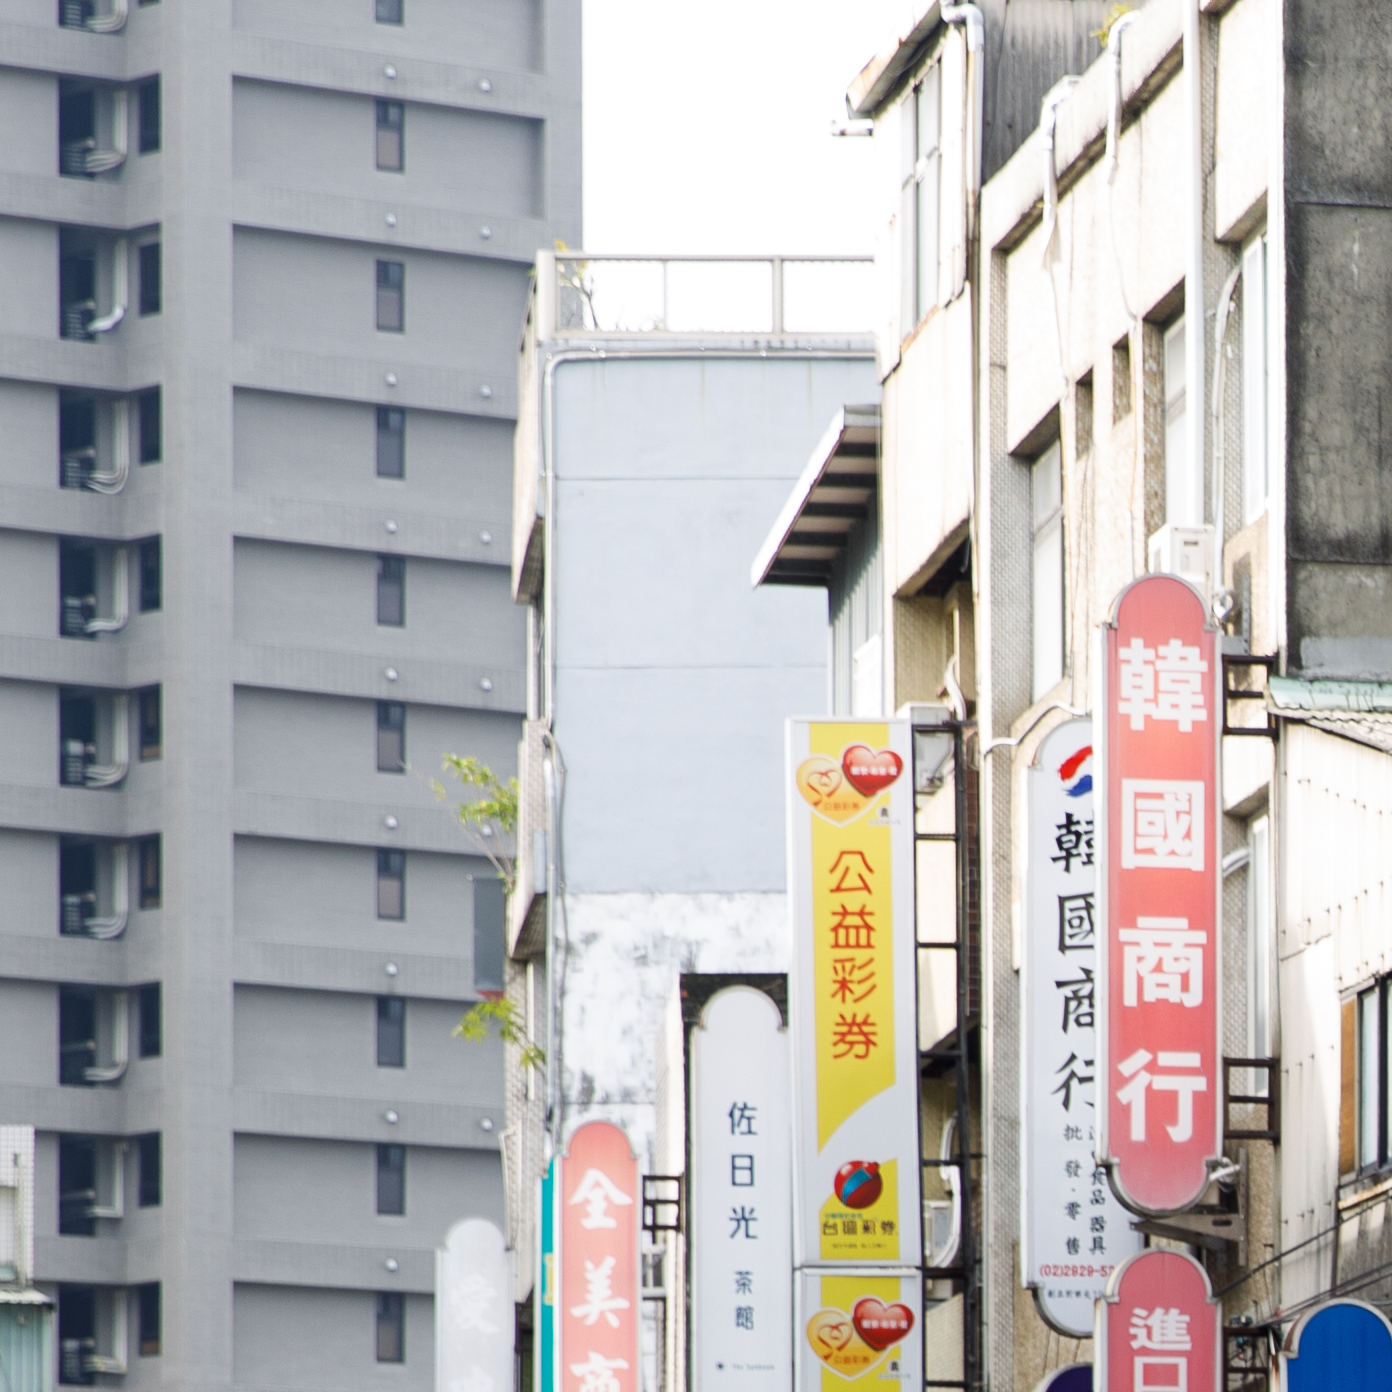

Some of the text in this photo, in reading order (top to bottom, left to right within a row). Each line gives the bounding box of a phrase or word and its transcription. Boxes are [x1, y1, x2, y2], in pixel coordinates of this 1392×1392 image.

[829, 850, 878, 1060] 公益彩券
[1117, 638, 1208, 1143] 韓國商行
